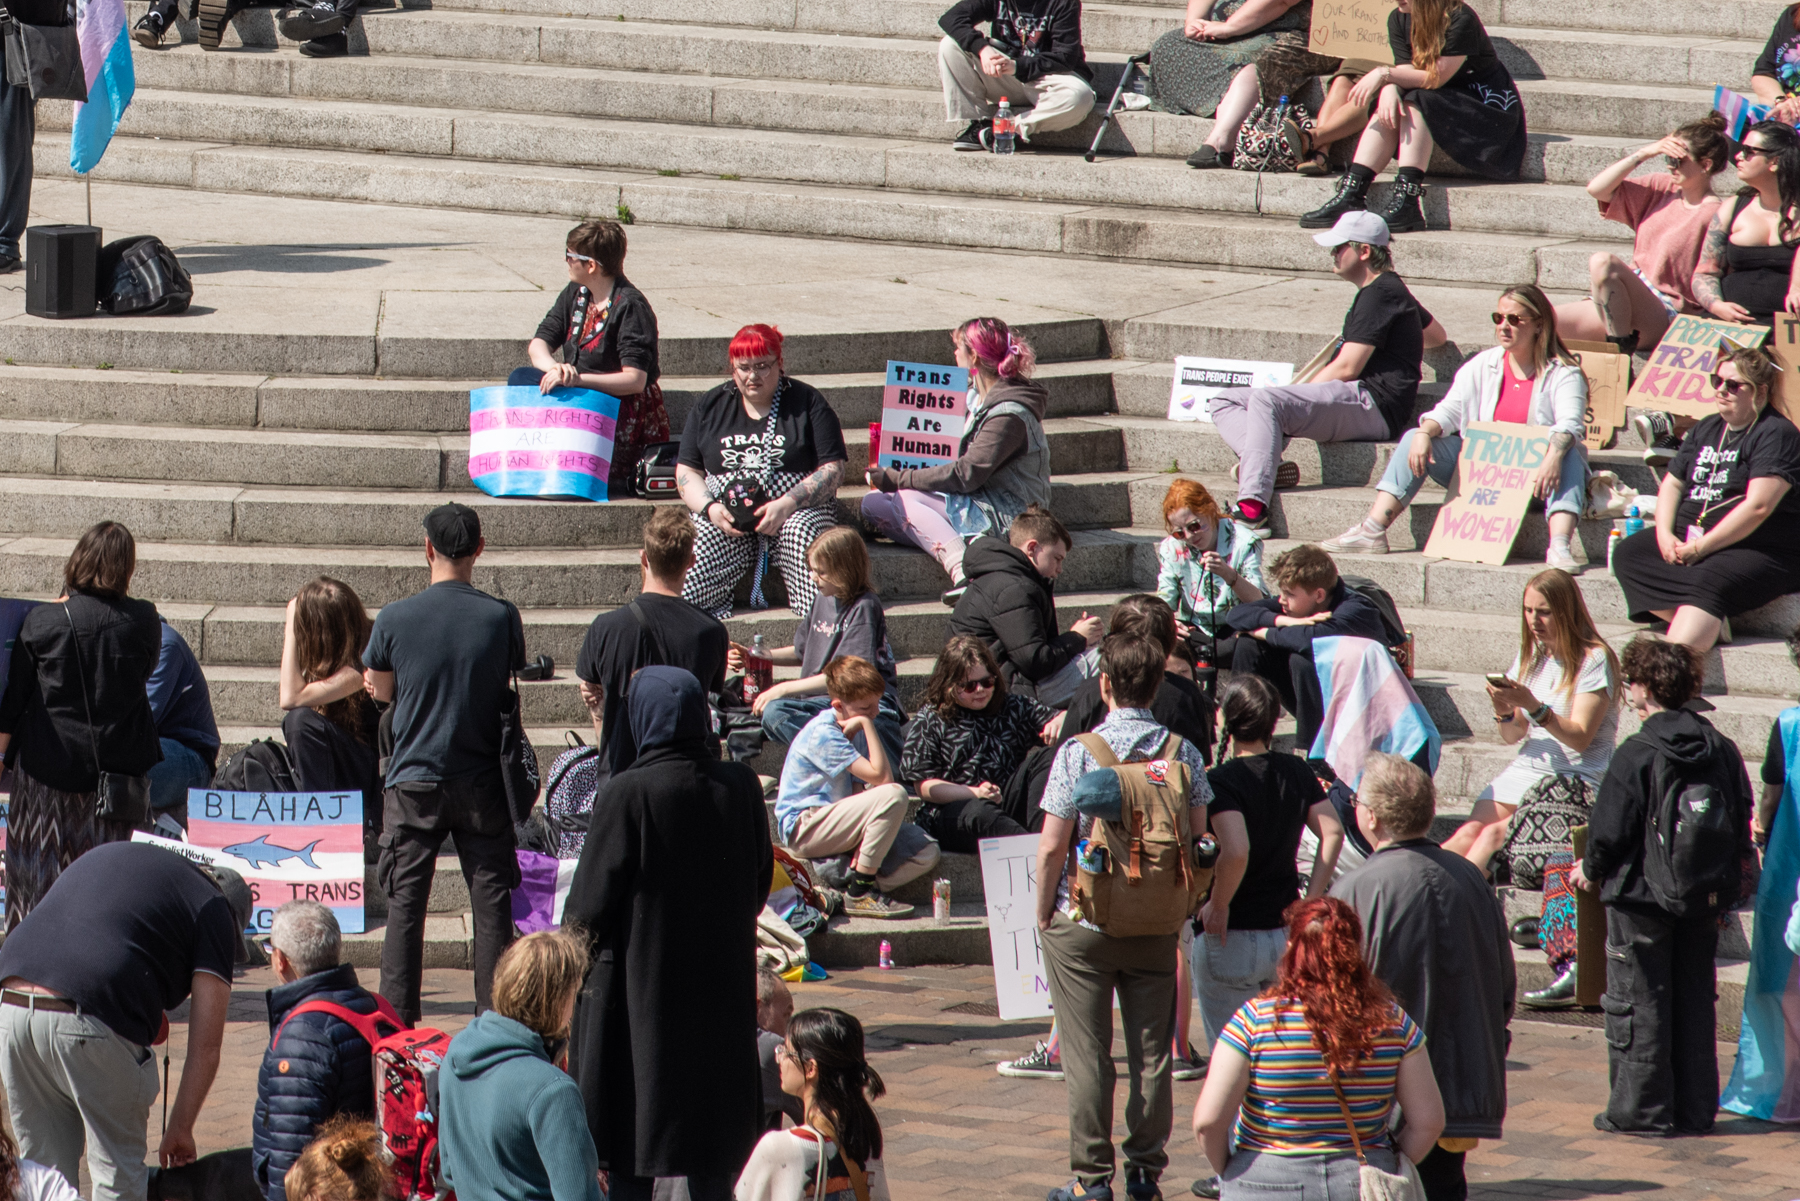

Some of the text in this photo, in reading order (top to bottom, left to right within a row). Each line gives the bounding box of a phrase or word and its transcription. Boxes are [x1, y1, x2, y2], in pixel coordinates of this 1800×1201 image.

[895, 365, 952, 386] Trans
[1182, 369, 1253, 386] TRANS PEOPLE EXIST
[898, 388, 955, 410] Rights
[545, 409, 604, 431] RIGHTS
[907, 416, 942, 433] Are
[515, 431, 555, 446] ARE
[892, 435, 952, 457] Human
[1464, 428, 1550, 469] TRANS
[1468, 461, 1530, 490] WOMEN
[1468, 488, 1501, 506] ARE
[1442, 507, 1520, 544] WOMEN
[205, 792, 351, 822] BLÅHAJ
[184, 847, 216, 865] Worker
[286, 882, 362, 903] TRANS
